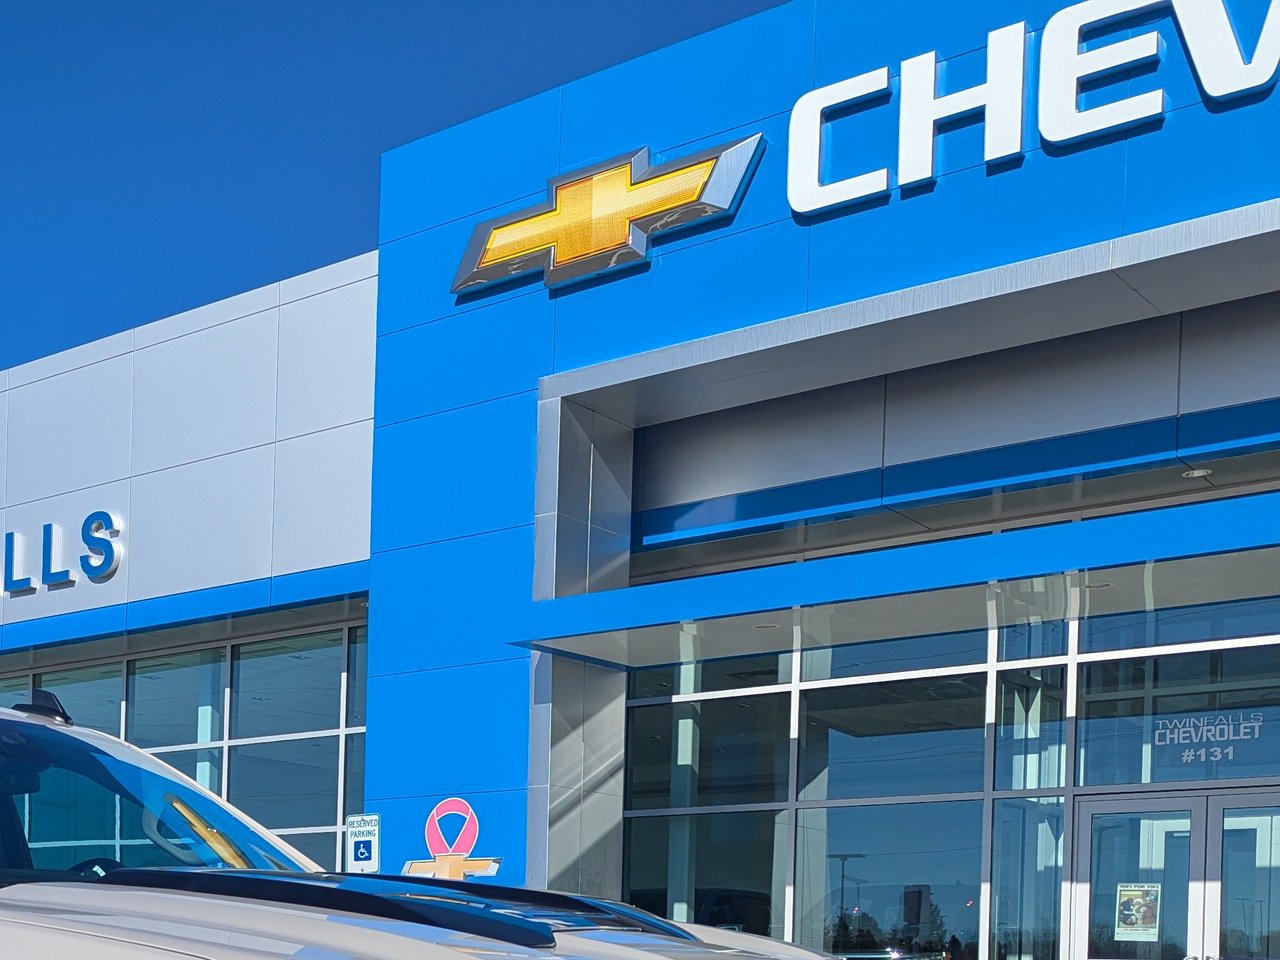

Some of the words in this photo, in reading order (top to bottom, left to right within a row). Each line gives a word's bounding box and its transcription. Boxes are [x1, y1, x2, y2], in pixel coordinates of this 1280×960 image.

[1154, 722, 1263, 746] CHEVROLET
[1181, 746, 1234, 763] #131
[348, 818, 378, 829] RESERVED
[350, 829, 376, 839] PARKING
